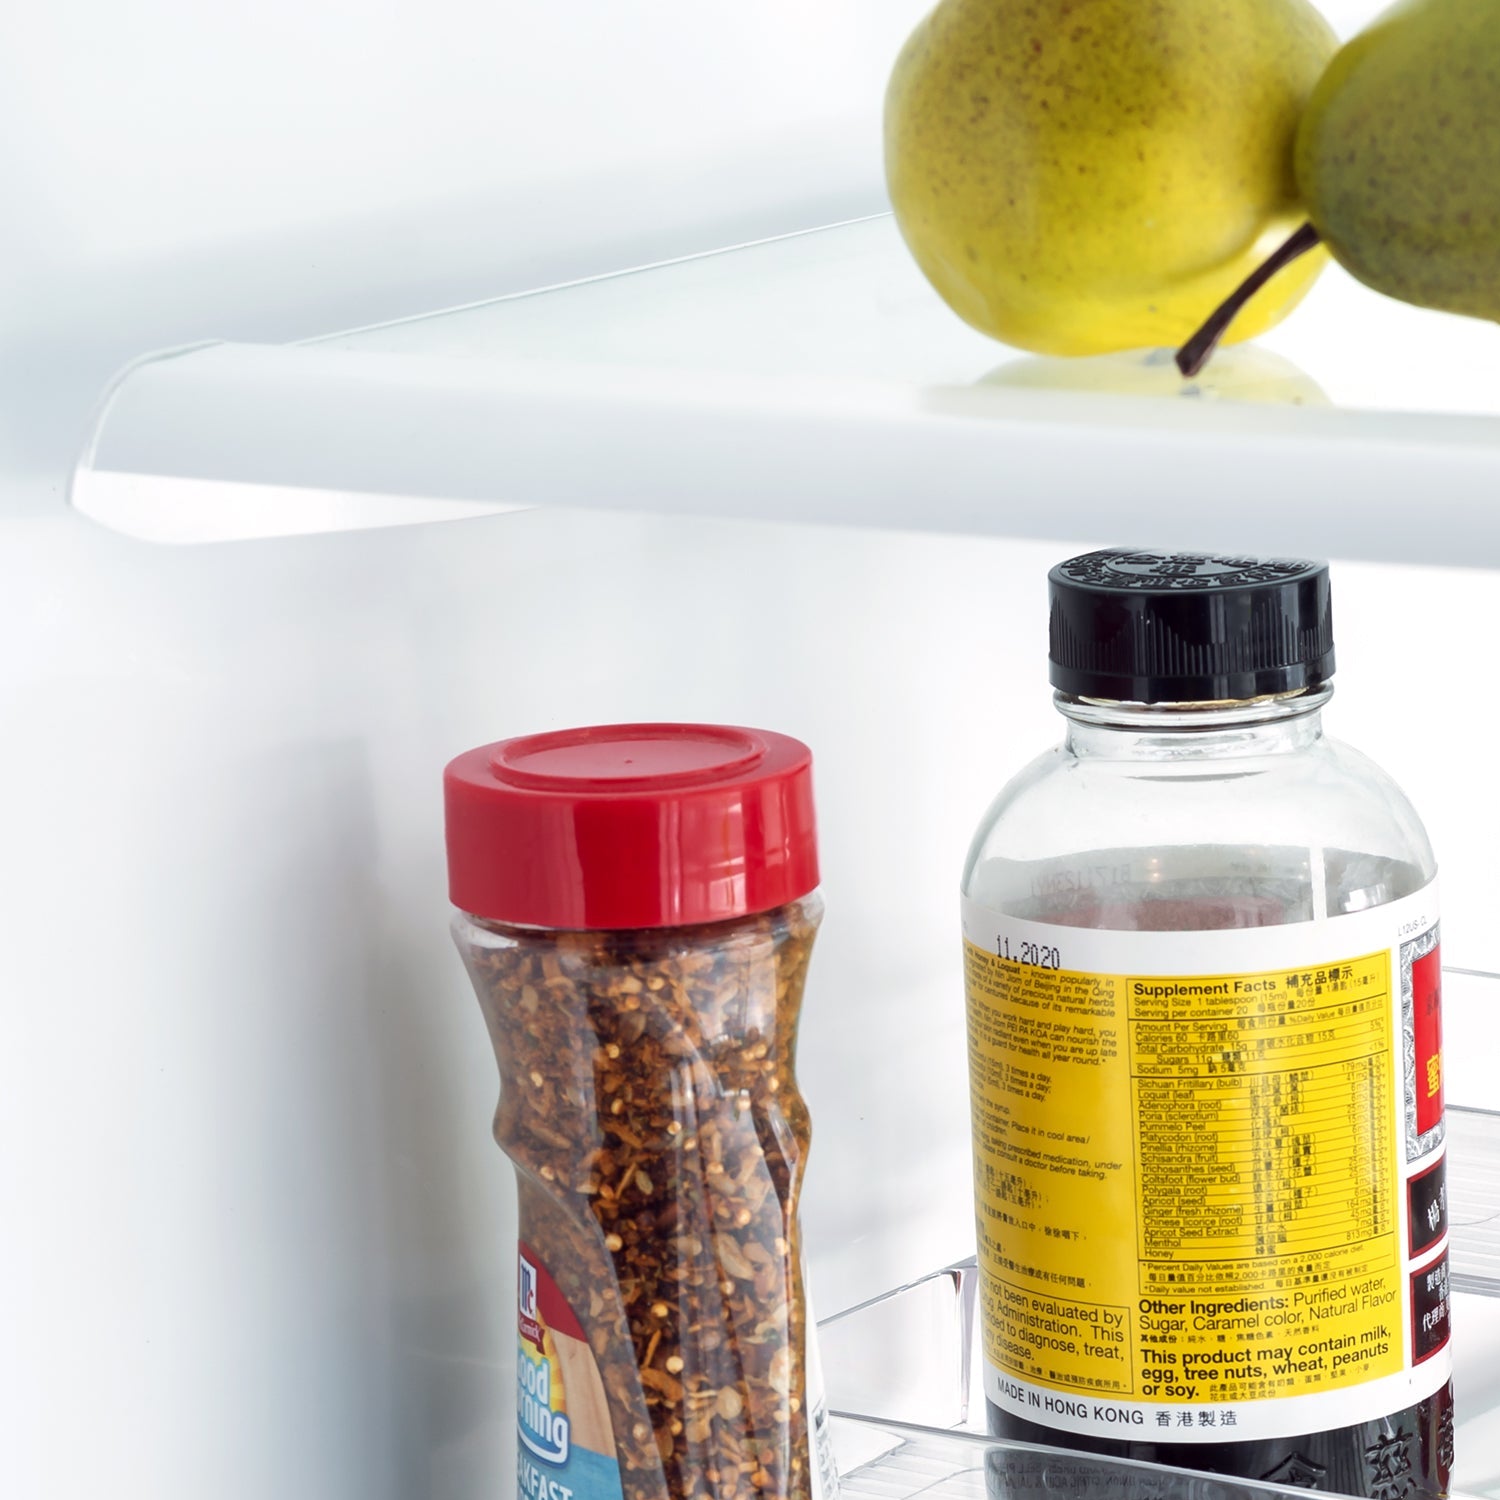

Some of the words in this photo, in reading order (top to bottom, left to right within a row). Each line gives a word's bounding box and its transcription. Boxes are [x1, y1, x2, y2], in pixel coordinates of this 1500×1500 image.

[997, 934, 1060, 971] 11.2020
[1025, 977, 1033, 987] of
[1034, 979, 1061, 993] Beijing
[1064, 983, 1072, 992] in
[1075, 985, 1089, 996] the
[1092, 987, 1115, 1000] Qing
[1031, 968, 1057, 980] known
[1060, 975, 1101, 988] popularly
[1105, 978, 1115, 988] in
[1021, 988, 1055, 1002] precious
[1056, 993, 1086, 1006] natural
[1089, 996, 1115, 1009] herbs
[1134, 982, 1229, 999] Supplement
[1234, 979, 1277, 993] Facts
[1134, 997, 1169, 1008] Serving
[1172, 997, 1191, 1007] Size
[1206, 994, 1257, 1006] tablespoon
[1260, 991, 1288, 1004] (15ml)
[1010, 996, 1040, 1009] because
[1042, 1001, 1050, 1010] of
[1052, 1002, 1062, 1013] its
[1065, 1005, 1116, 1019] remarkable
[1134, 1008, 1169, 1019] Serving
[1172, 1009, 1187, 1018] per
[1190, 1007, 1234, 1017] container
[1236, 1005, 1249, 1015] 20
[1019, 1015, 1035, 1027] hard
[1036, 1018, 1052, 1031] and
[1054, 1022, 1071, 1035] play
[1073, 1024, 1096, 1037] hard,
[1099, 1029, 1117, 1040] you
[1019, 1024, 1029, 1035] PA
[1030, 1027, 1048, 1040] KOA
[1049, 1032, 1065, 1043] can
[1066, 1035, 1100, 1047] nourish
[1102, 1037, 1117, 1048] the
[1136, 1021, 1171, 1032] Amount
[1174, 1021, 1189, 1031] Per
[1193, 1020, 1228, 1032] Serving
[1136, 1032, 1173, 1042] Calories
[1176, 1032, 1188, 1042] 60
[1137, 1043, 1157, 1053] Total
[1161, 1040, 1225, 1053] Carbohydrate
[1231, 1041, 1248, 1052] 15g
[1031, 1038, 1051, 1050] when
[1053, 1042, 1068, 1055] you
[1070, 1045, 1084, 1056] are
[1086, 1047, 1099, 1059] up
[1100, 1047, 1118, 1058] late
[1042, 1048, 1051, 1060] all
[1052, 1052, 1070, 1064] year
[1157, 1053, 1190, 1065] Sugars
[1196, 1055, 1213, 1065] 11g
[1137, 1065, 1172, 1075] Sodium
[1178, 1064, 1199, 1075] 5mg
[1138, 1079, 1174, 1089] Sichuan
[1178, 1078, 1213, 1090] Fritillary
[1217, 1077, 1242, 1089] (bulb)
[1138, 1089, 1170, 1100] Loquat
[1173, 1088, 1194, 1101] (leaf)
[1139, 1099, 1195, 1111] Adenophora
[1198, 1099, 1222, 1110] (root)
[1011, 1120, 1030, 1134] Place
[1047, 1130, 1064, 1142] cool
[1140, 1121, 1183, 1131] Pummelo
[1186, 1120, 1206, 1131] Peel
[1024, 1157, 1048, 1171] doctor
[1049, 1162, 1075, 1176] before
[1078, 1167, 1107, 1182] taking.
[1042, 1153, 1091, 1169] medication,
[1094, 1160, 1122, 1172] under
[1144, 1227, 1176, 1238] Apricot
[1179, 1226, 1203, 1237] Seed
[1206, 1226, 1239, 1236] Extract
[1145, 1237, 1181, 1248] Menthol
[1145, 1249, 1174, 1260] Honey
[1004, 1287, 1029, 1308] been
[1032, 1299, 1099, 1323] evaluated
[1103, 1309, 1124, 1329] by
[1139, 1299, 1186, 1315] Other
[1190, 1297, 1289, 1318] Ingredients:
[1294, 1284, 1347, 1307] Purified
[1350, 1277, 1386, 1297] water,
[997, 1299, 1082, 1338] Administration.
[1091, 1324, 1124, 1343] This
[1139, 1315, 1188, 1335] Sugar,
[1193, 1313, 1260, 1331] Caramel
[1264, 1310, 1304, 1327] color,
[1309, 1297, 1358, 1321] Natural
[1362, 1289, 1397, 1311] Flavor
[996, 1333, 1034, 1361] disease.
[1007, 1320, 1017, 1338] to
[1019, 1326, 1080, 1357] diagnose,
[1084, 1341, 1124, 1362] treat,
[1140, 1349, 1177, 1364] This
[1182, 1348, 1251, 1367] product
[1257, 1346, 1293, 1363] may
[1298, 1334, 1356, 1357] contain
[1360, 1324, 1391, 1344] milk,
[1141, 1367, 1178, 1384] egg,
[1184, 1365, 1219, 1380] tree
[1224, 1364, 1267, 1380] nuts,
[1273, 1356, 1328, 1376] wheat,
[1333, 1343, 1389, 1370] peanuts
[518, 1353, 549, 1405] ood
[997, 1377, 1025, 1403] MADE
[1028, 1390, 1040, 1408] IN
[1045, 1396, 1087, 1419] HONG
[1094, 1405, 1144, 1425] KONG
[1155, 1409, 1239, 1428] 香港製造
[1142, 1384, 1160, 1396] or
[1165, 1384, 1200, 1400] soy.
[518, 1388, 568, 1464] rning
